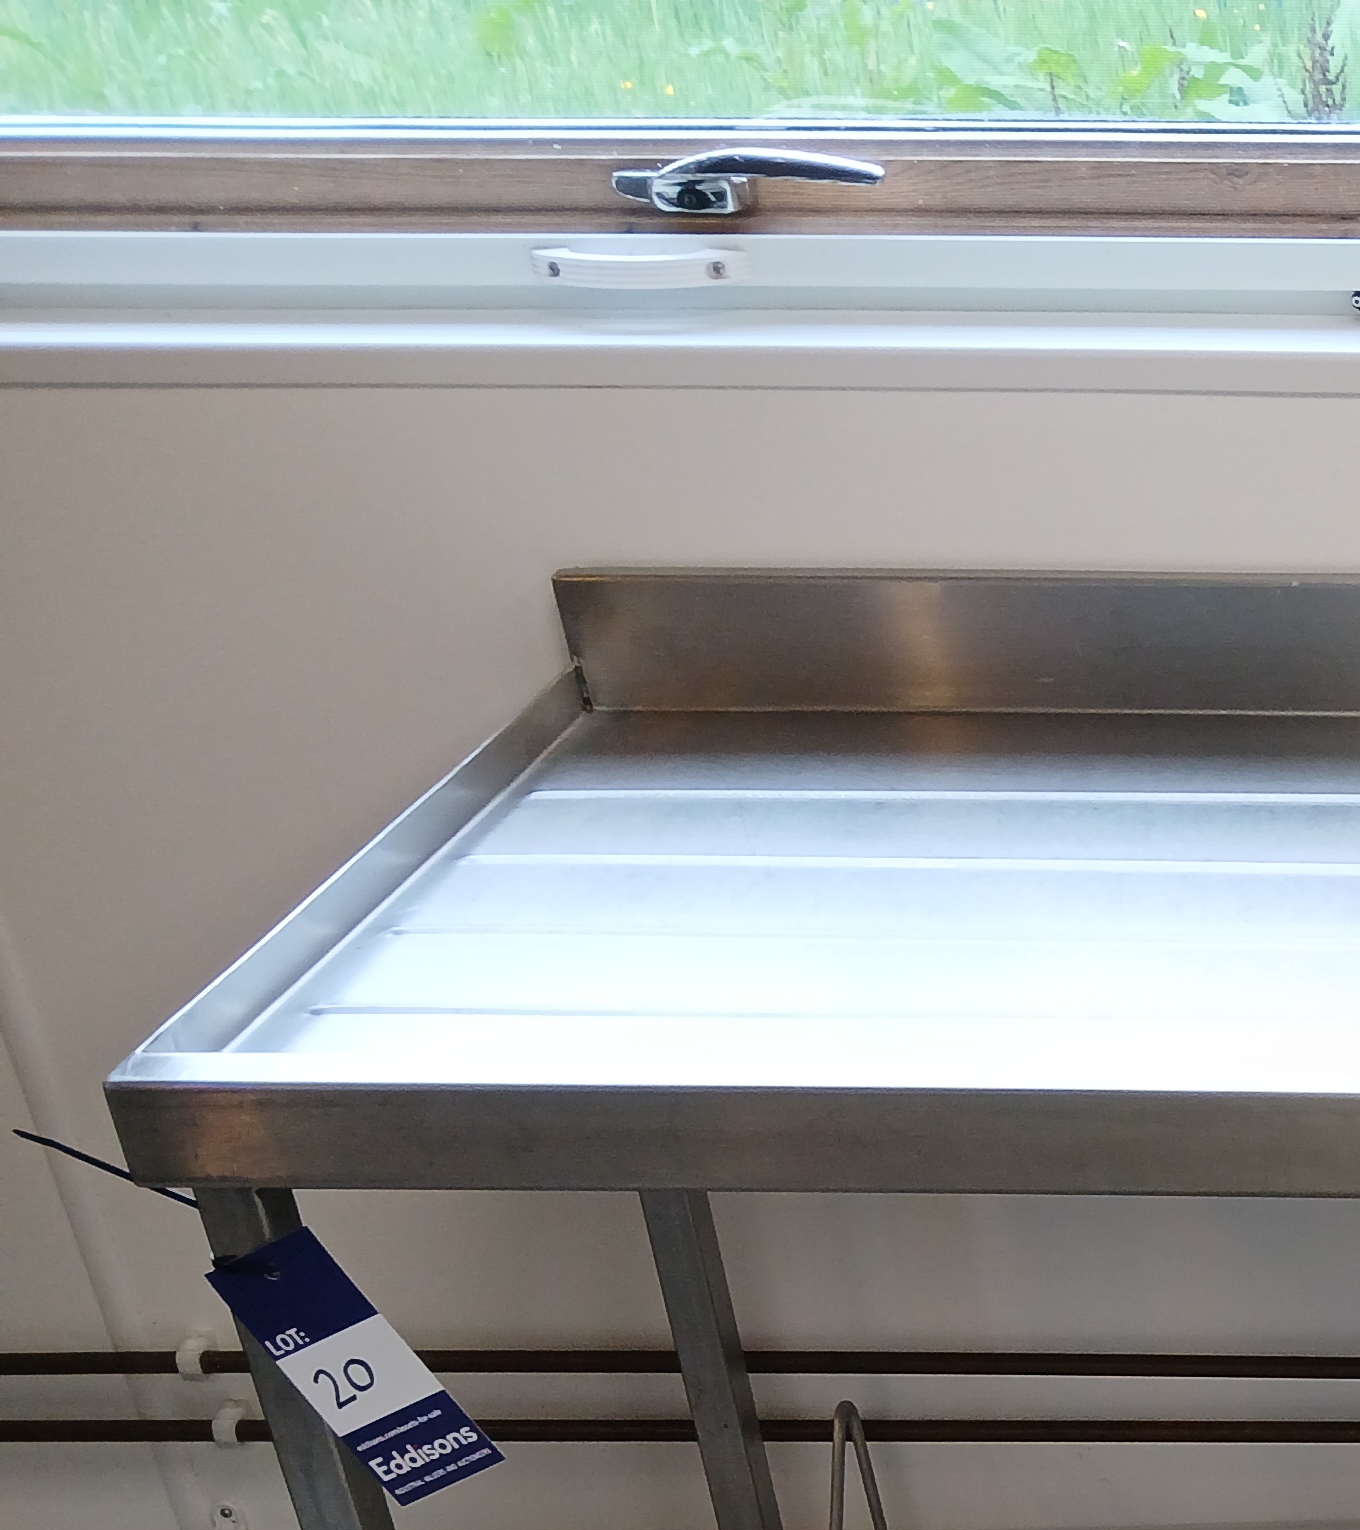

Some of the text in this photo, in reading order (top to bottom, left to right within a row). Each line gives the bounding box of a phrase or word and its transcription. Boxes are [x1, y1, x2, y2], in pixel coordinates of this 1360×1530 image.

[264, 1327, 311, 1356] LOT:
[313, 1358, 375, 1410] 20
[368, 1426, 479, 1482] Eddisons
